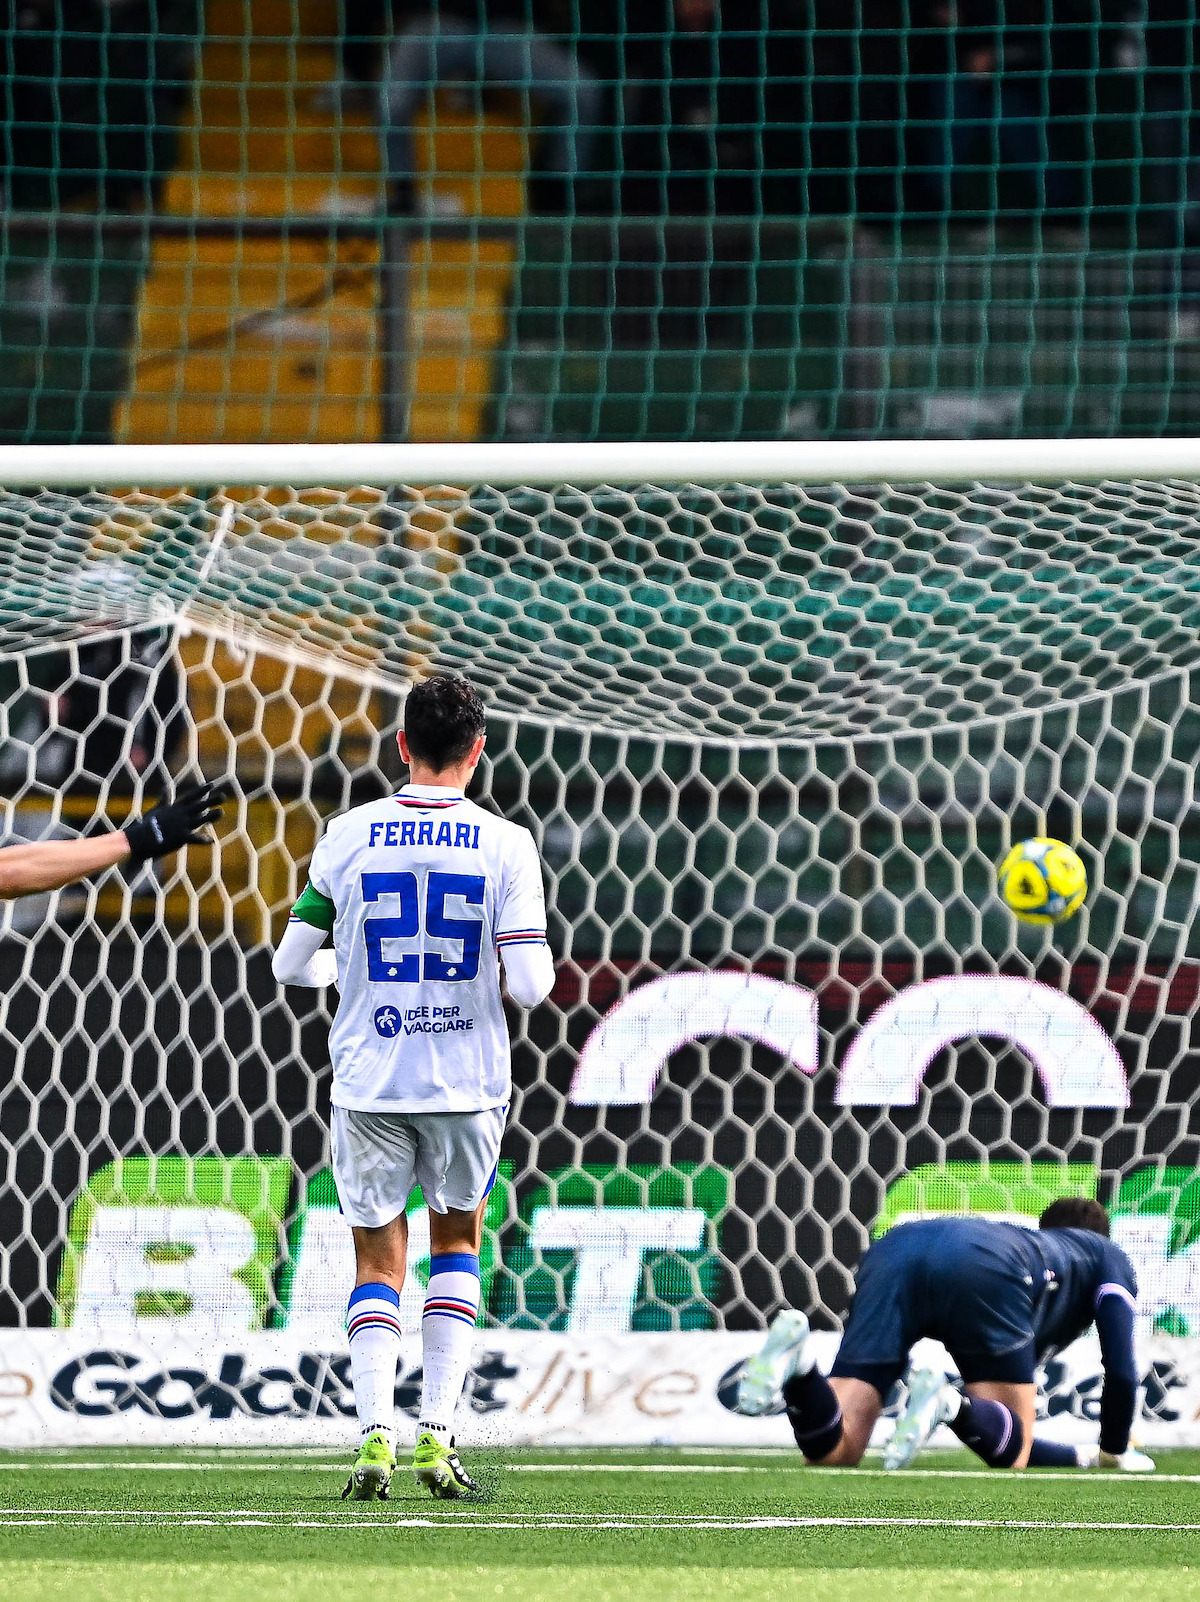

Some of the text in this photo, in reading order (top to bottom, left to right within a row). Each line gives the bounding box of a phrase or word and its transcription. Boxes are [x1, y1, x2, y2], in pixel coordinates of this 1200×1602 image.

[368, 821, 480, 849] FERRARI
[360, 870, 486, 984] 25
[403, 1018, 474, 1036] VAGGIARE
[404, 1005, 461, 1021] IDEE PER
[514, 1350, 698, 1417] live
